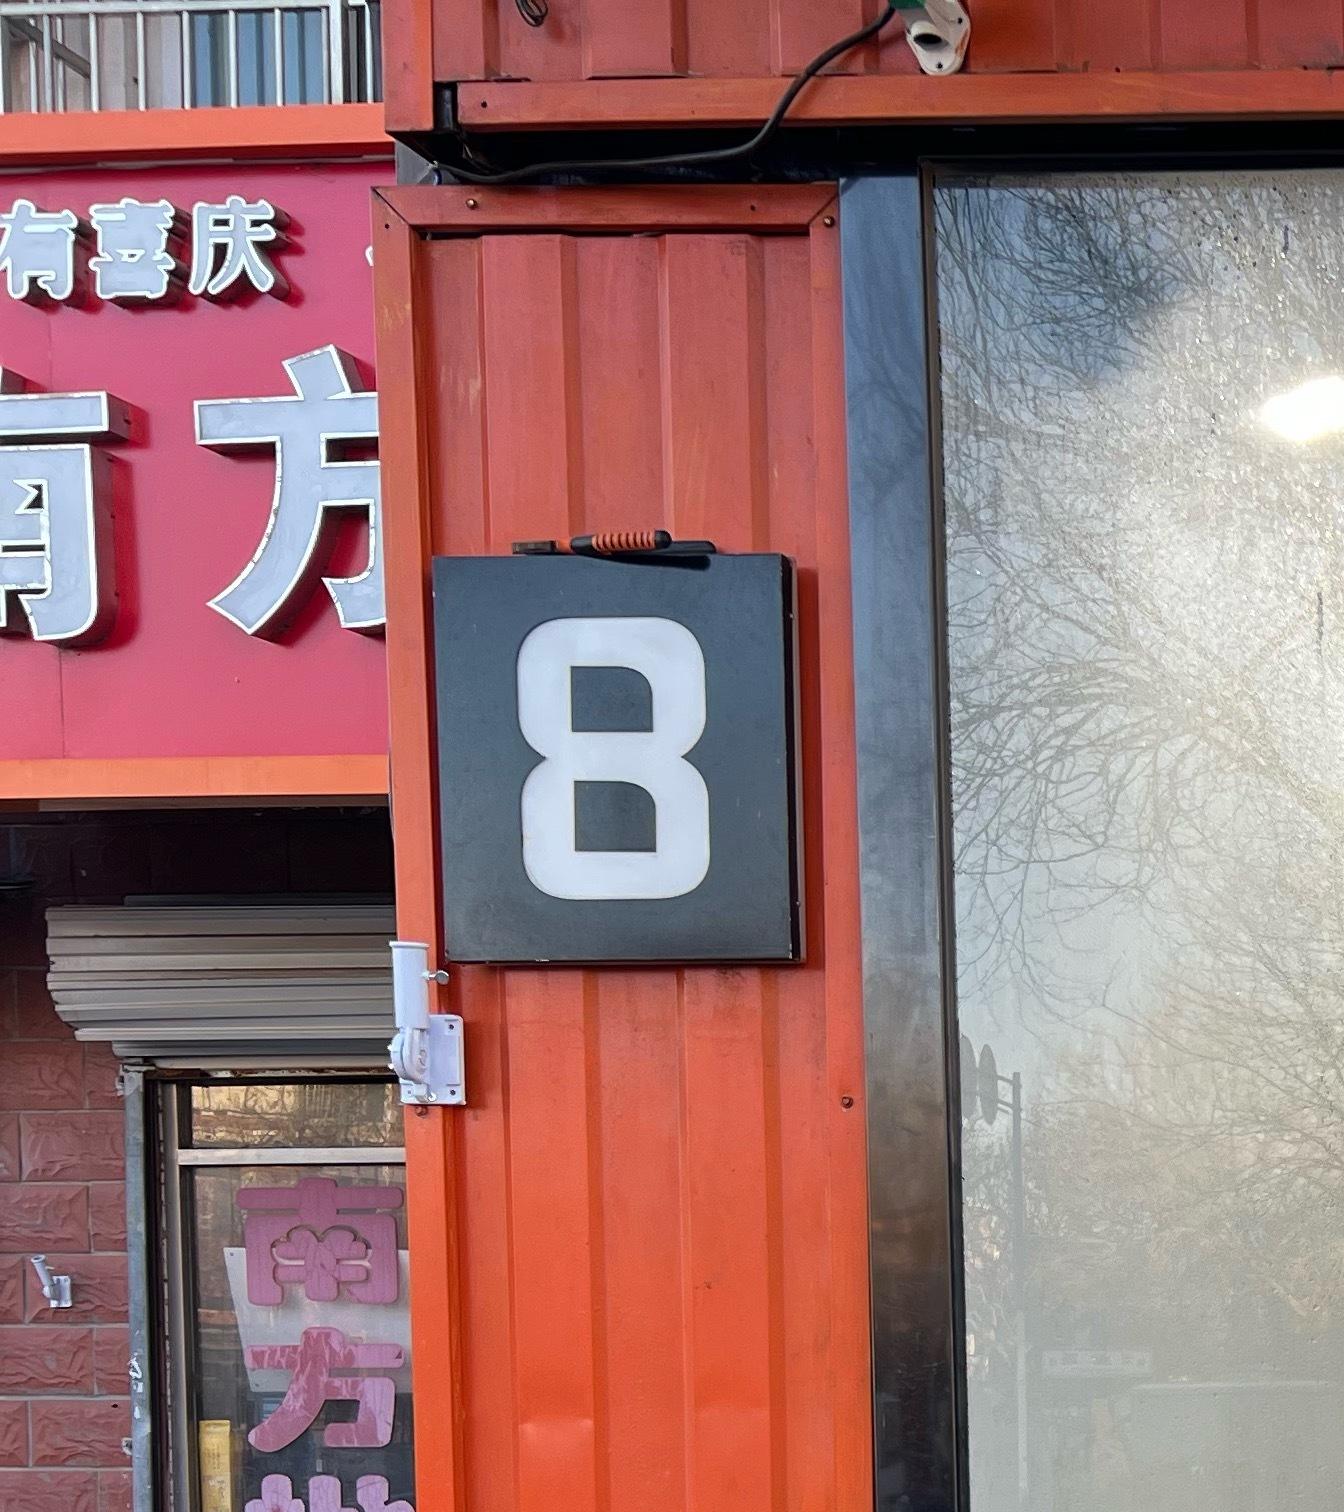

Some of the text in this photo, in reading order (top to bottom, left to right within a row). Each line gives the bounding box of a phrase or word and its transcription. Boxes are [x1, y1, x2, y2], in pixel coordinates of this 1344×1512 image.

[0, 195, 277, 300] 有喜庆
[516, 616, 711, 900] 8
